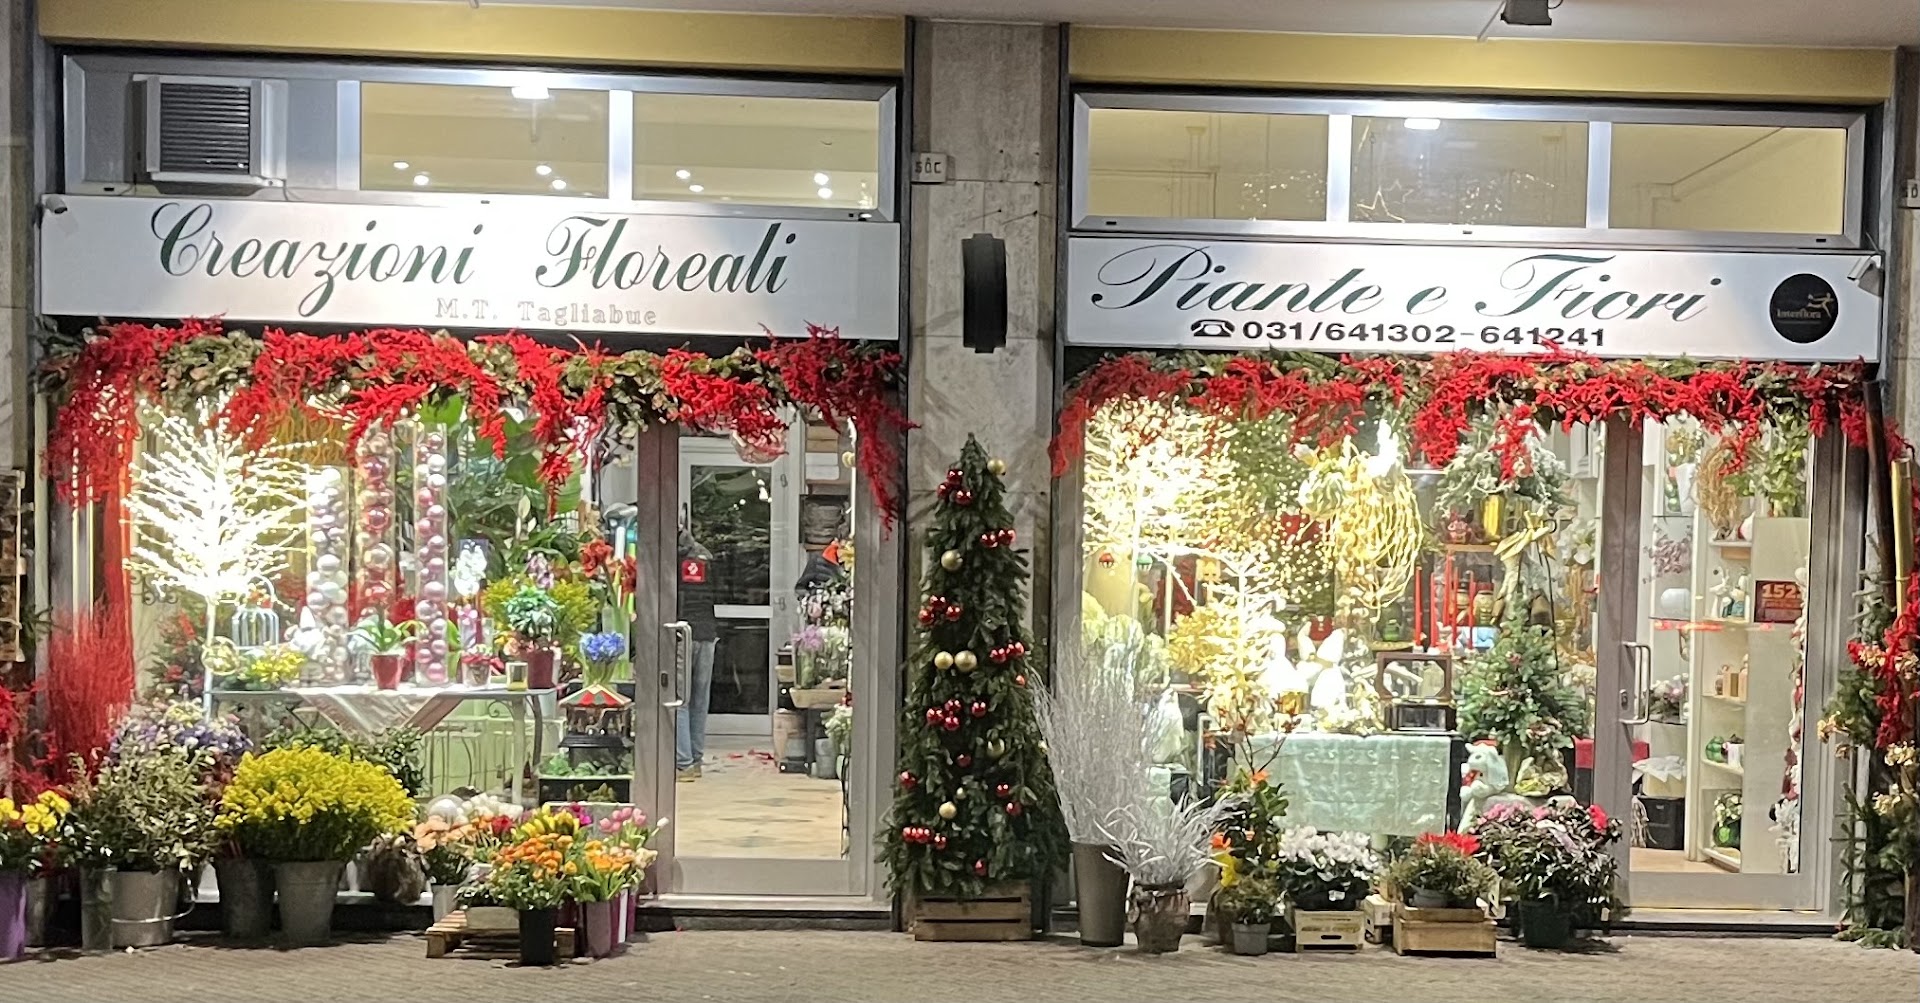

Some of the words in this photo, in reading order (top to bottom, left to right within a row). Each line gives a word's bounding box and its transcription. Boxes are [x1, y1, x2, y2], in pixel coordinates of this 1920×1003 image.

[150, 202, 483, 318] Creazioni
[535, 215, 797, 294] Floreali
[1091, 244, 1385, 314] Piante
[1406, 286, 1448, 315] e
[1474, 254, 1723, 322] Fiori
[434, 297, 498, 319] M.T.
[517, 300, 658, 326] Tagliabue
